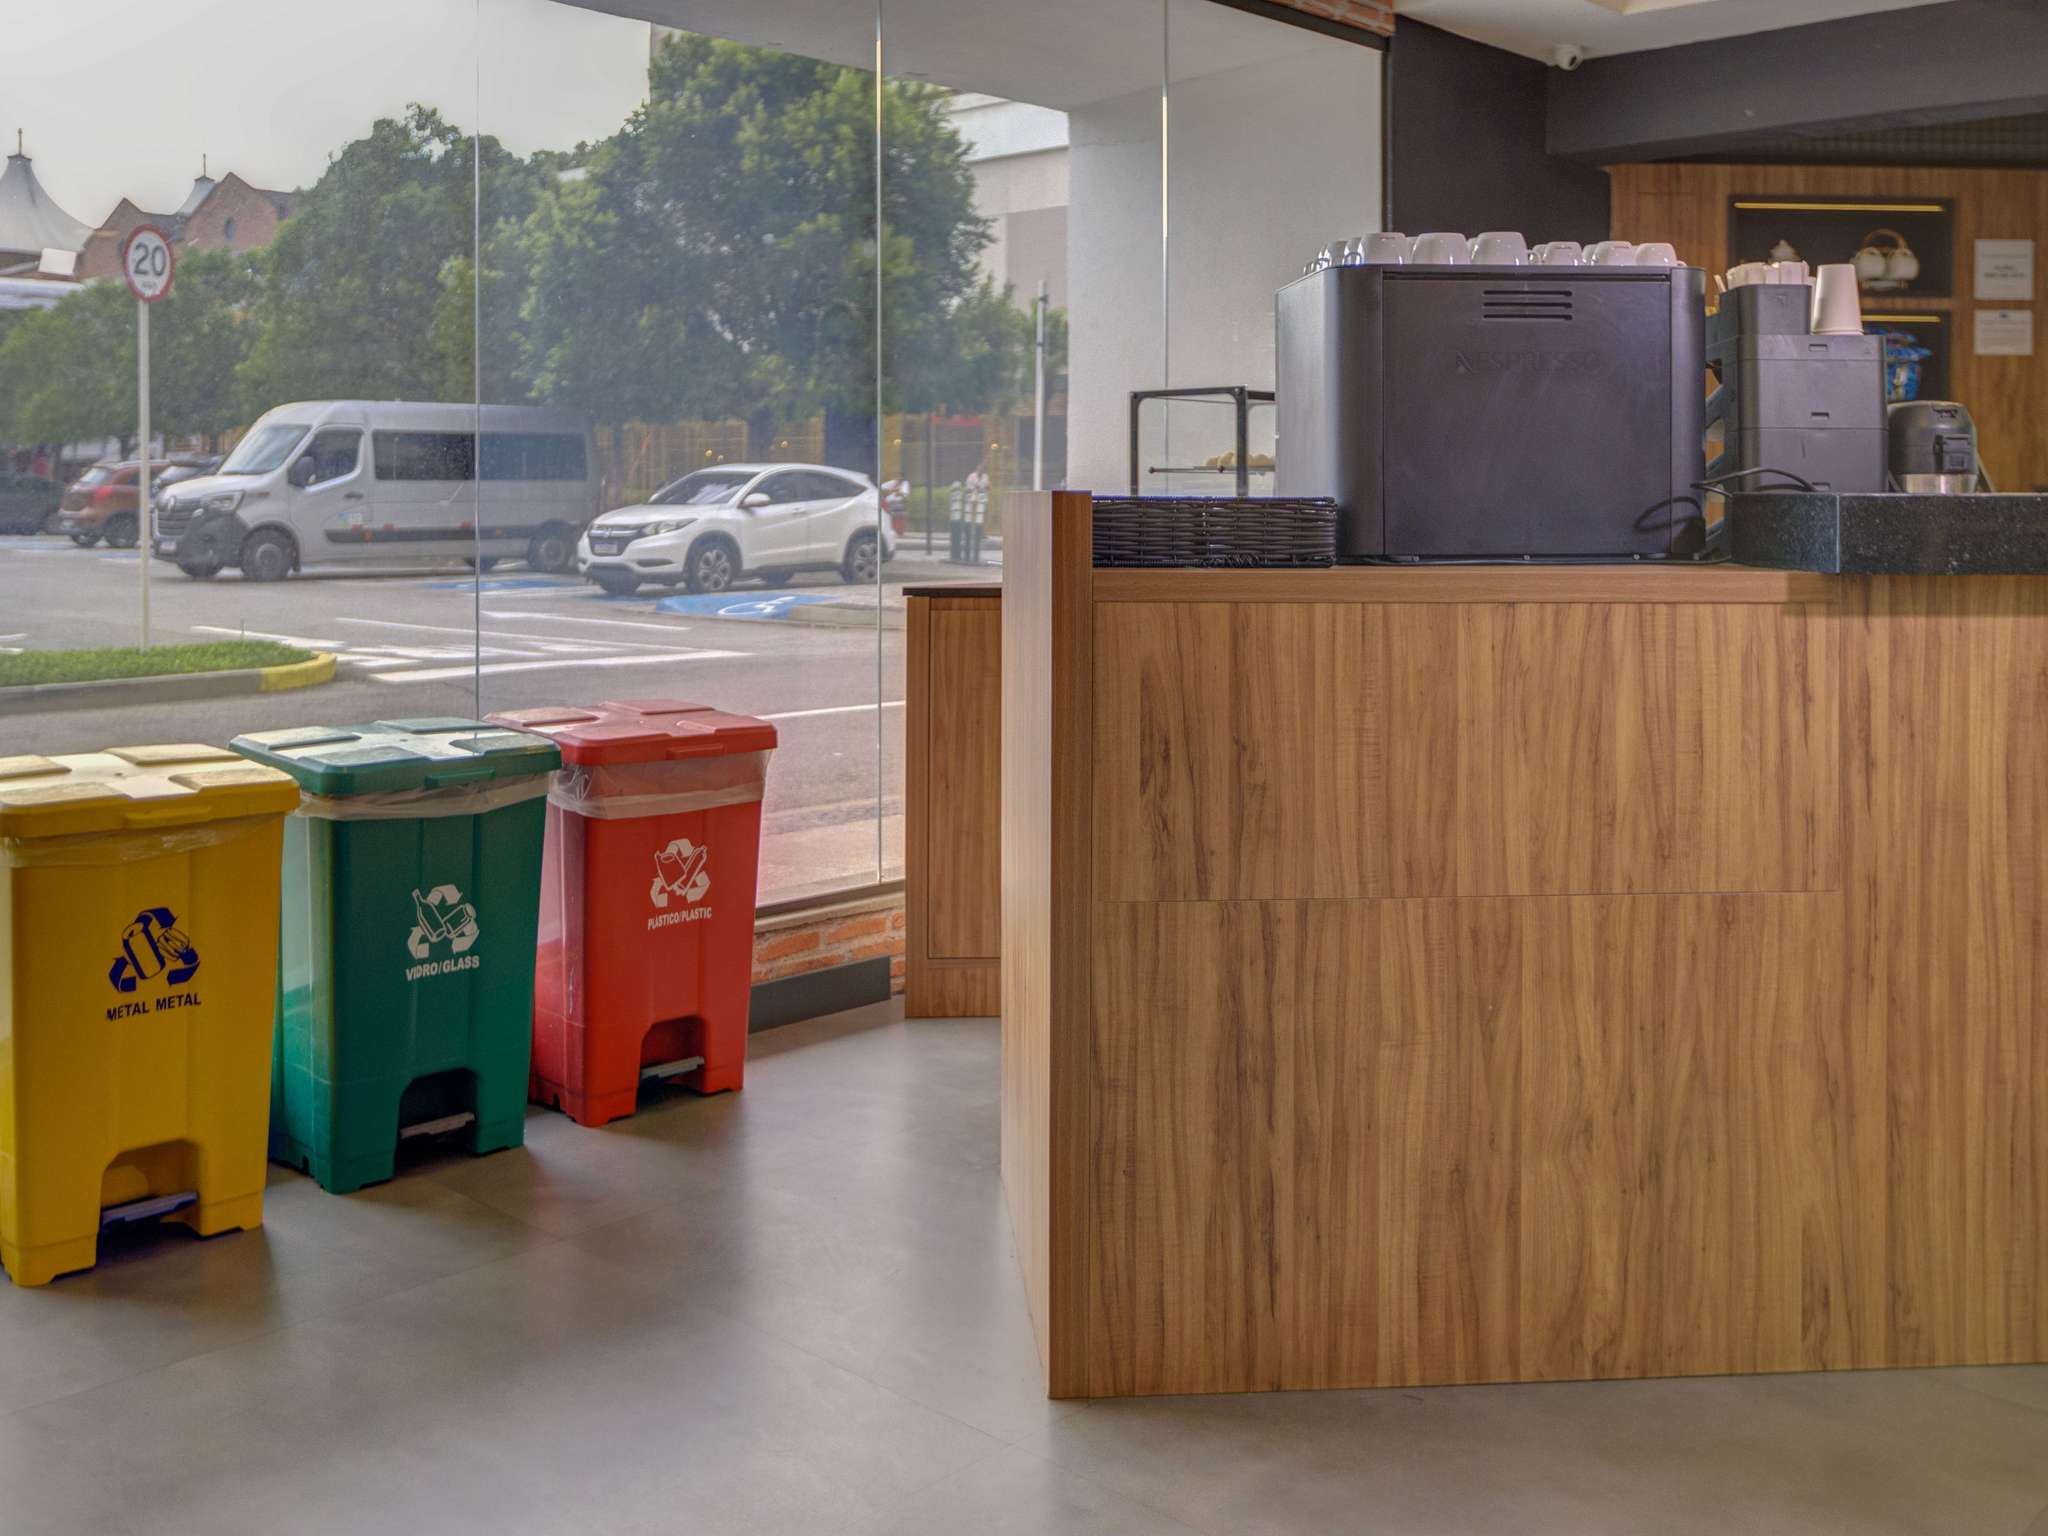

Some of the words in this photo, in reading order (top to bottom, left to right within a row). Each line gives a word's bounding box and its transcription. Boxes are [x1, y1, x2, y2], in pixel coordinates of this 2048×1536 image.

[135, 243, 166, 276] 20
[405, 955, 480, 981] VIDRO/GLASS
[106, 1001, 150, 1021] METAL
[156, 992, 202, 1011] METAL
